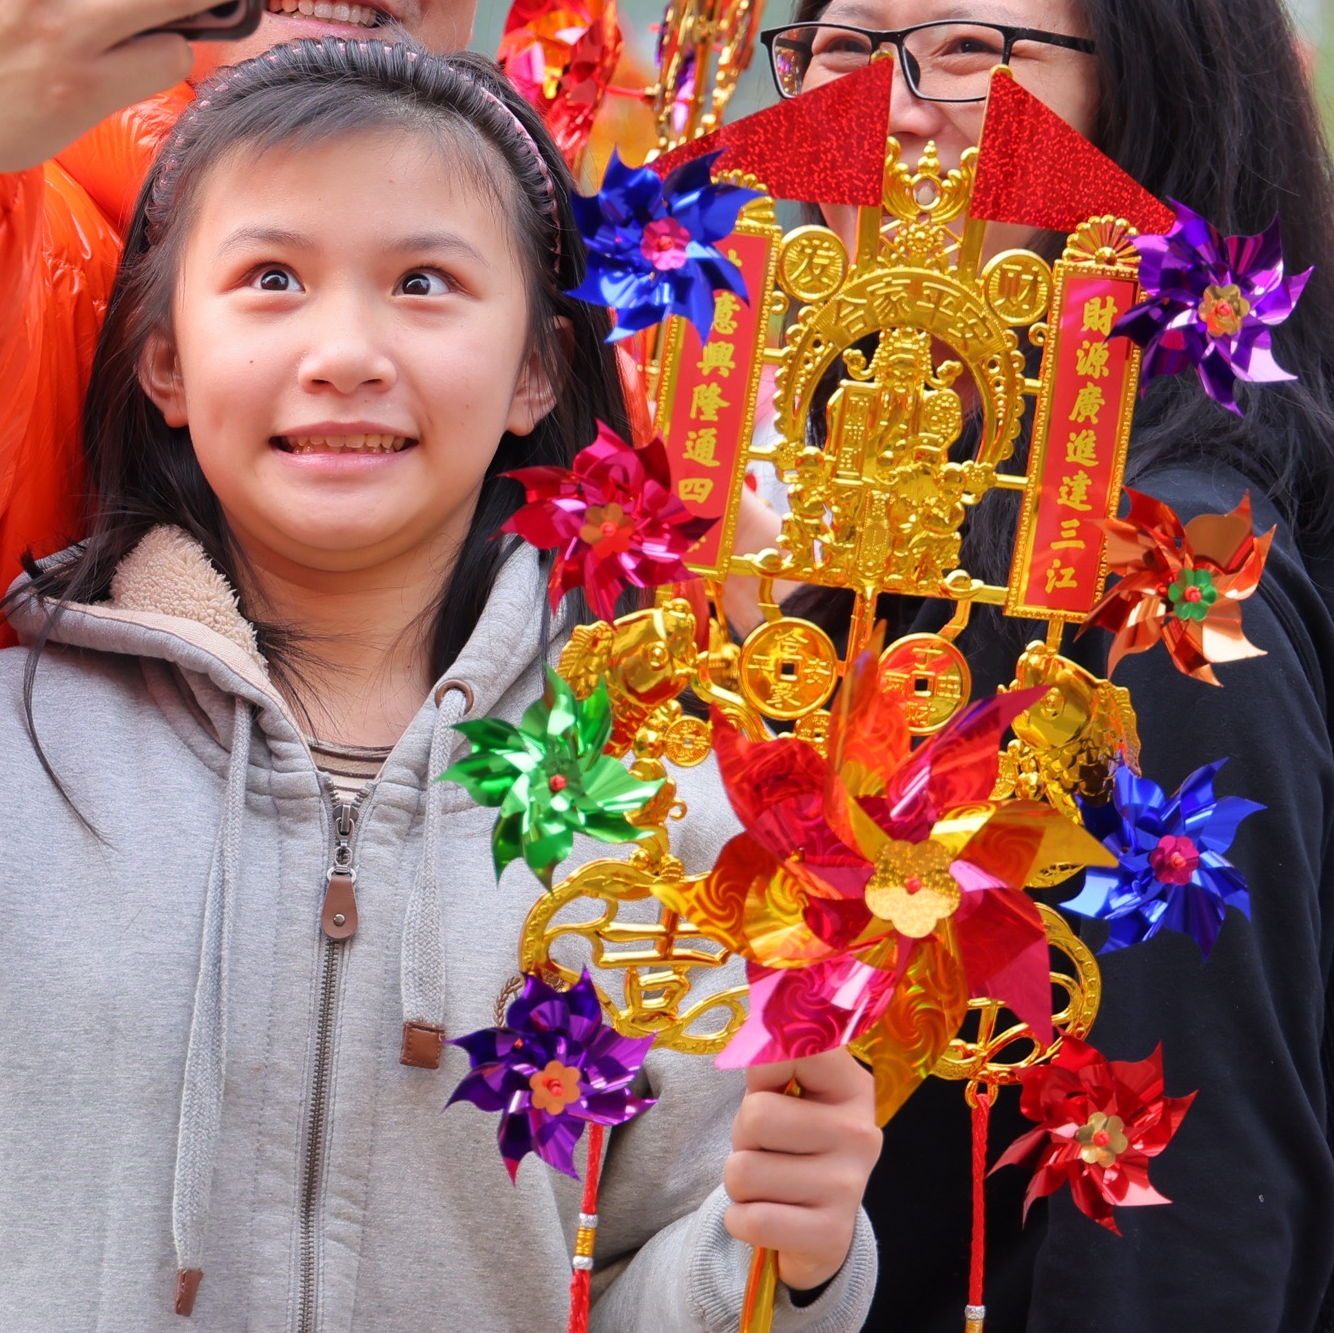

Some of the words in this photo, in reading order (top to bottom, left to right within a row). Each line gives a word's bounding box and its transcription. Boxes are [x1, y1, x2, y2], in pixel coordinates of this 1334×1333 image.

[677, 249, 742, 553] 意興隆通四
[1044, 295, 1118, 594] 財源廣進達三江
